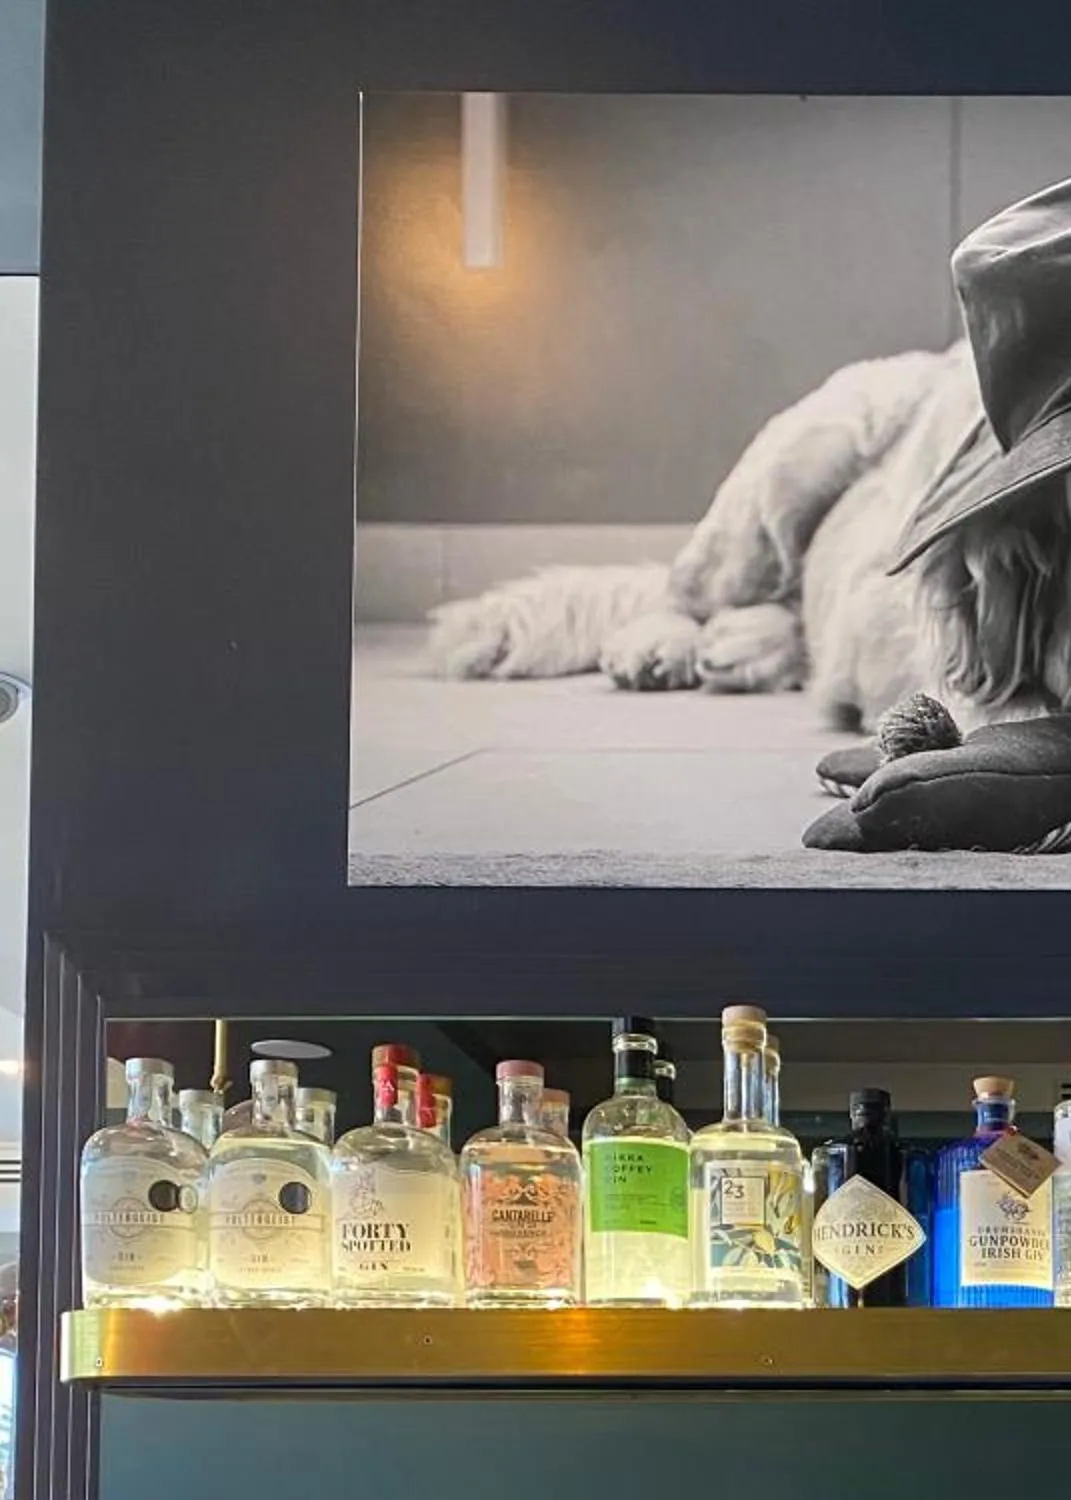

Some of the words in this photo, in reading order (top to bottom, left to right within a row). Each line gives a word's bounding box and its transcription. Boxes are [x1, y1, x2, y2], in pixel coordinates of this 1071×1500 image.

[724, 1180, 745, 1199] 23
[342, 1222, 410, 1240] FORTY
[814, 1220, 915, 1241] HENDRICK'S
[341, 1239, 411, 1252] SPOTTED
[981, 1247, 1021, 1260] IRISH
